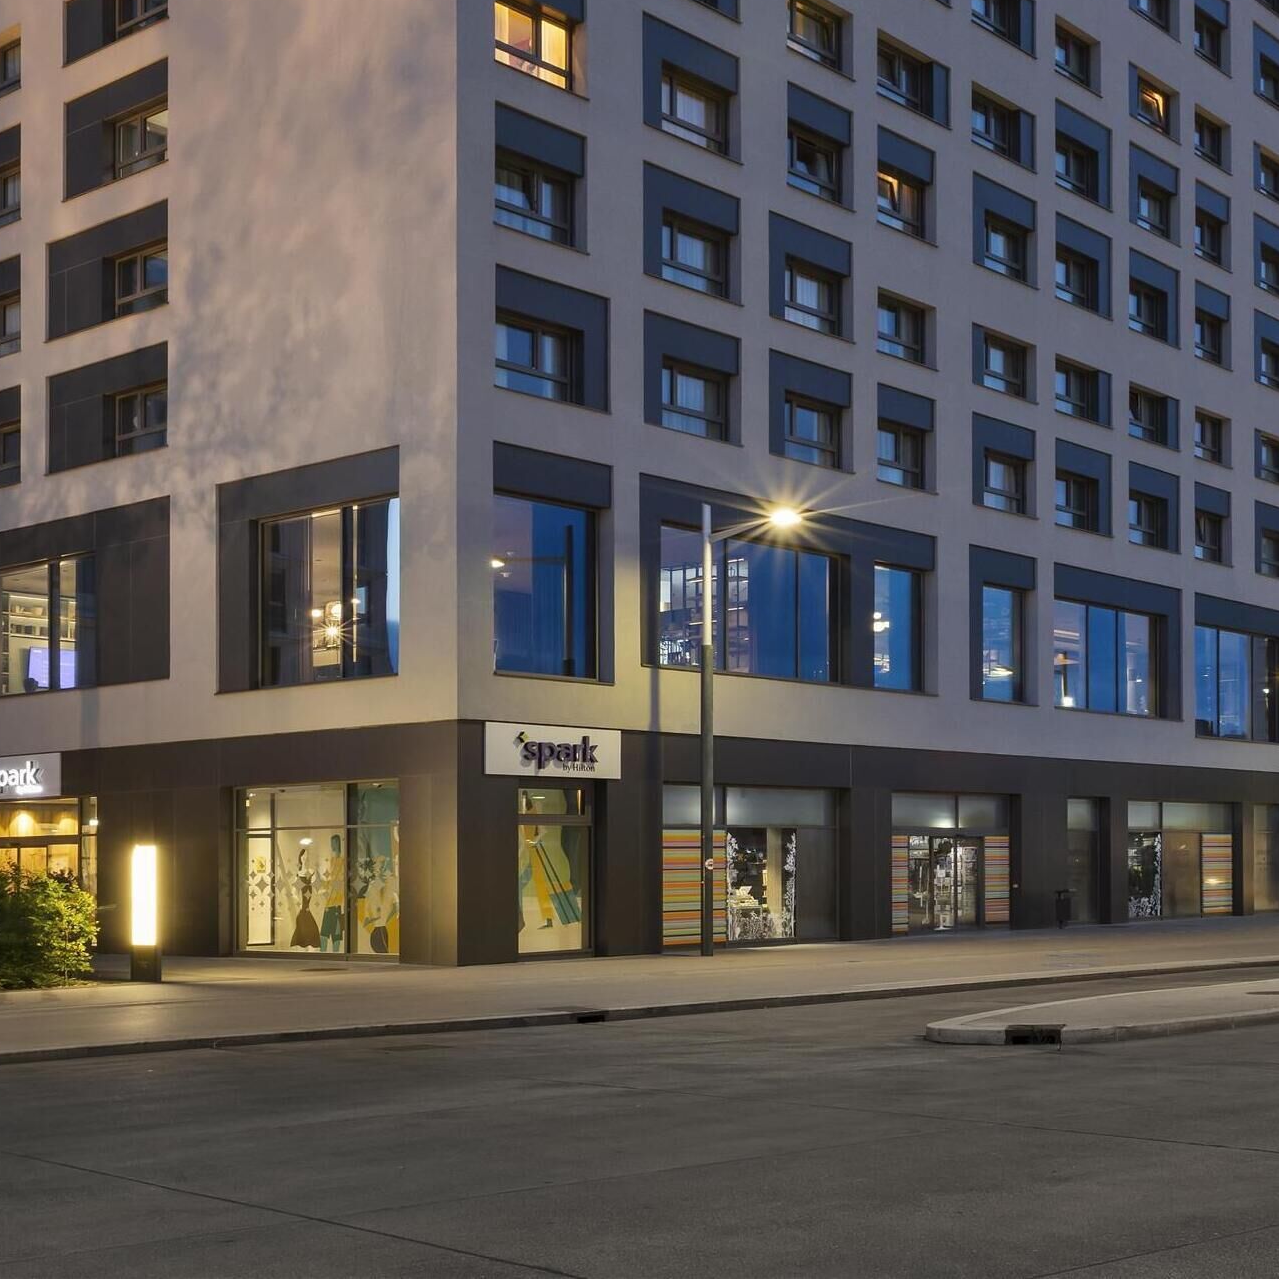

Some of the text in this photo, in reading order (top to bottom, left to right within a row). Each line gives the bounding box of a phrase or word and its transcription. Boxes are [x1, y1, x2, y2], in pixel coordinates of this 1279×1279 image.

[522, 735, 599, 770] spark
[562, 763, 596, 773] by Hilton
